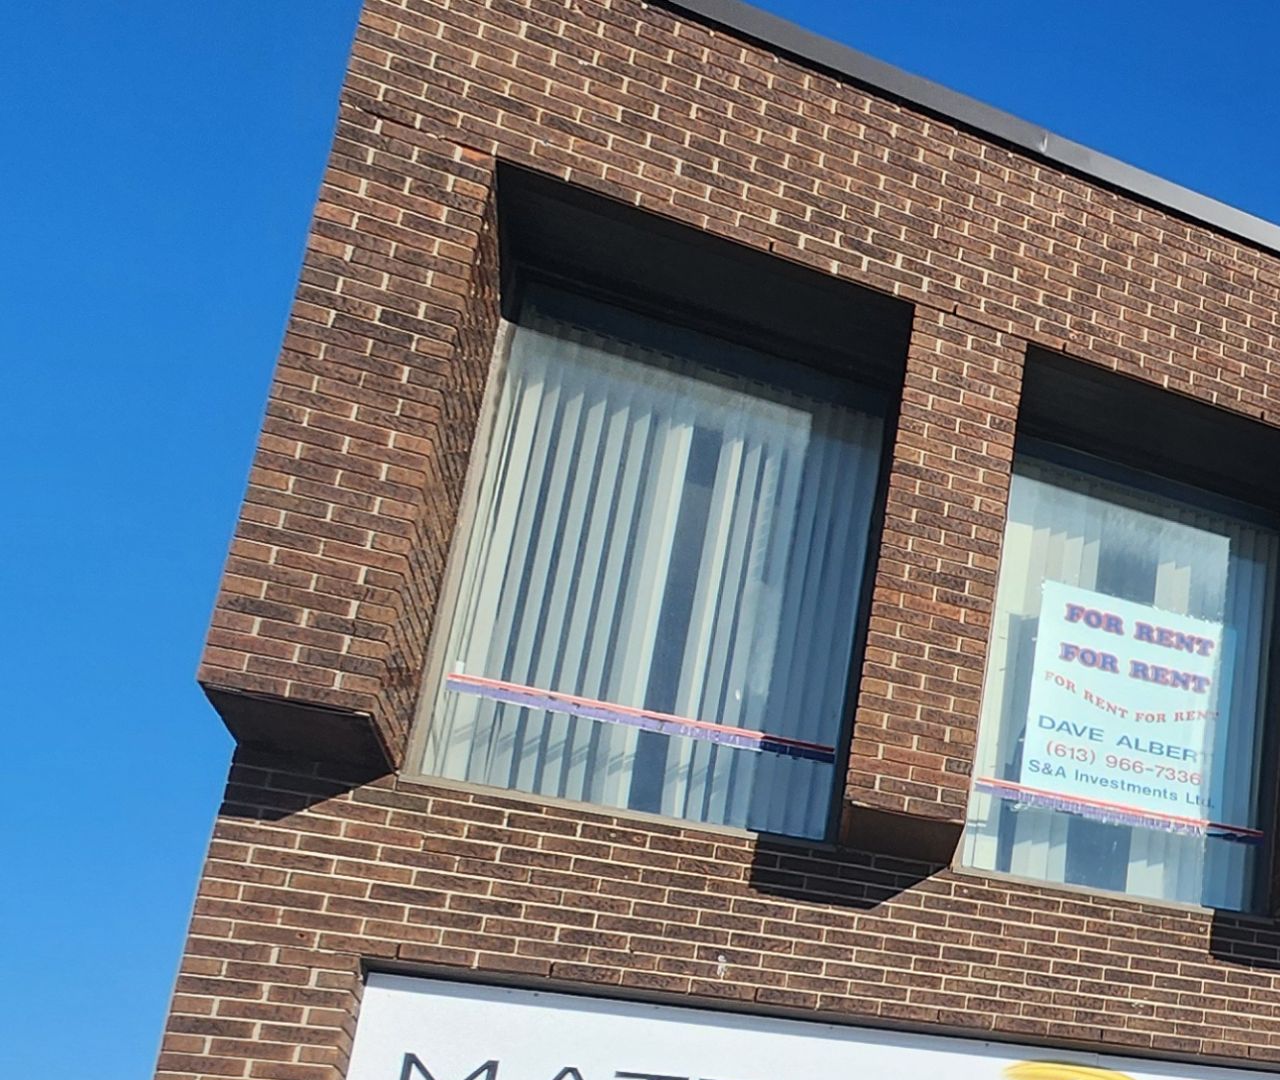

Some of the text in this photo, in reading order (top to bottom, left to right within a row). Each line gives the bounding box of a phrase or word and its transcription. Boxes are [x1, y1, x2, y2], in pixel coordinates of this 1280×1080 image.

[1064, 603, 1215, 657] FOR RENT
[1059, 642, 1211, 694] FOR RENT
[1045, 671, 1076, 693] FOR
[1084, 690, 1128, 719] RENT
[1135, 713, 1166, 723] FOR
[1038, 715, 1104, 742] DAVE
[1028, 759, 1066, 779] S&A
[1075, 769, 1178, 802] Investments
[1046, 740, 1202, 786] (613) 966-7336
